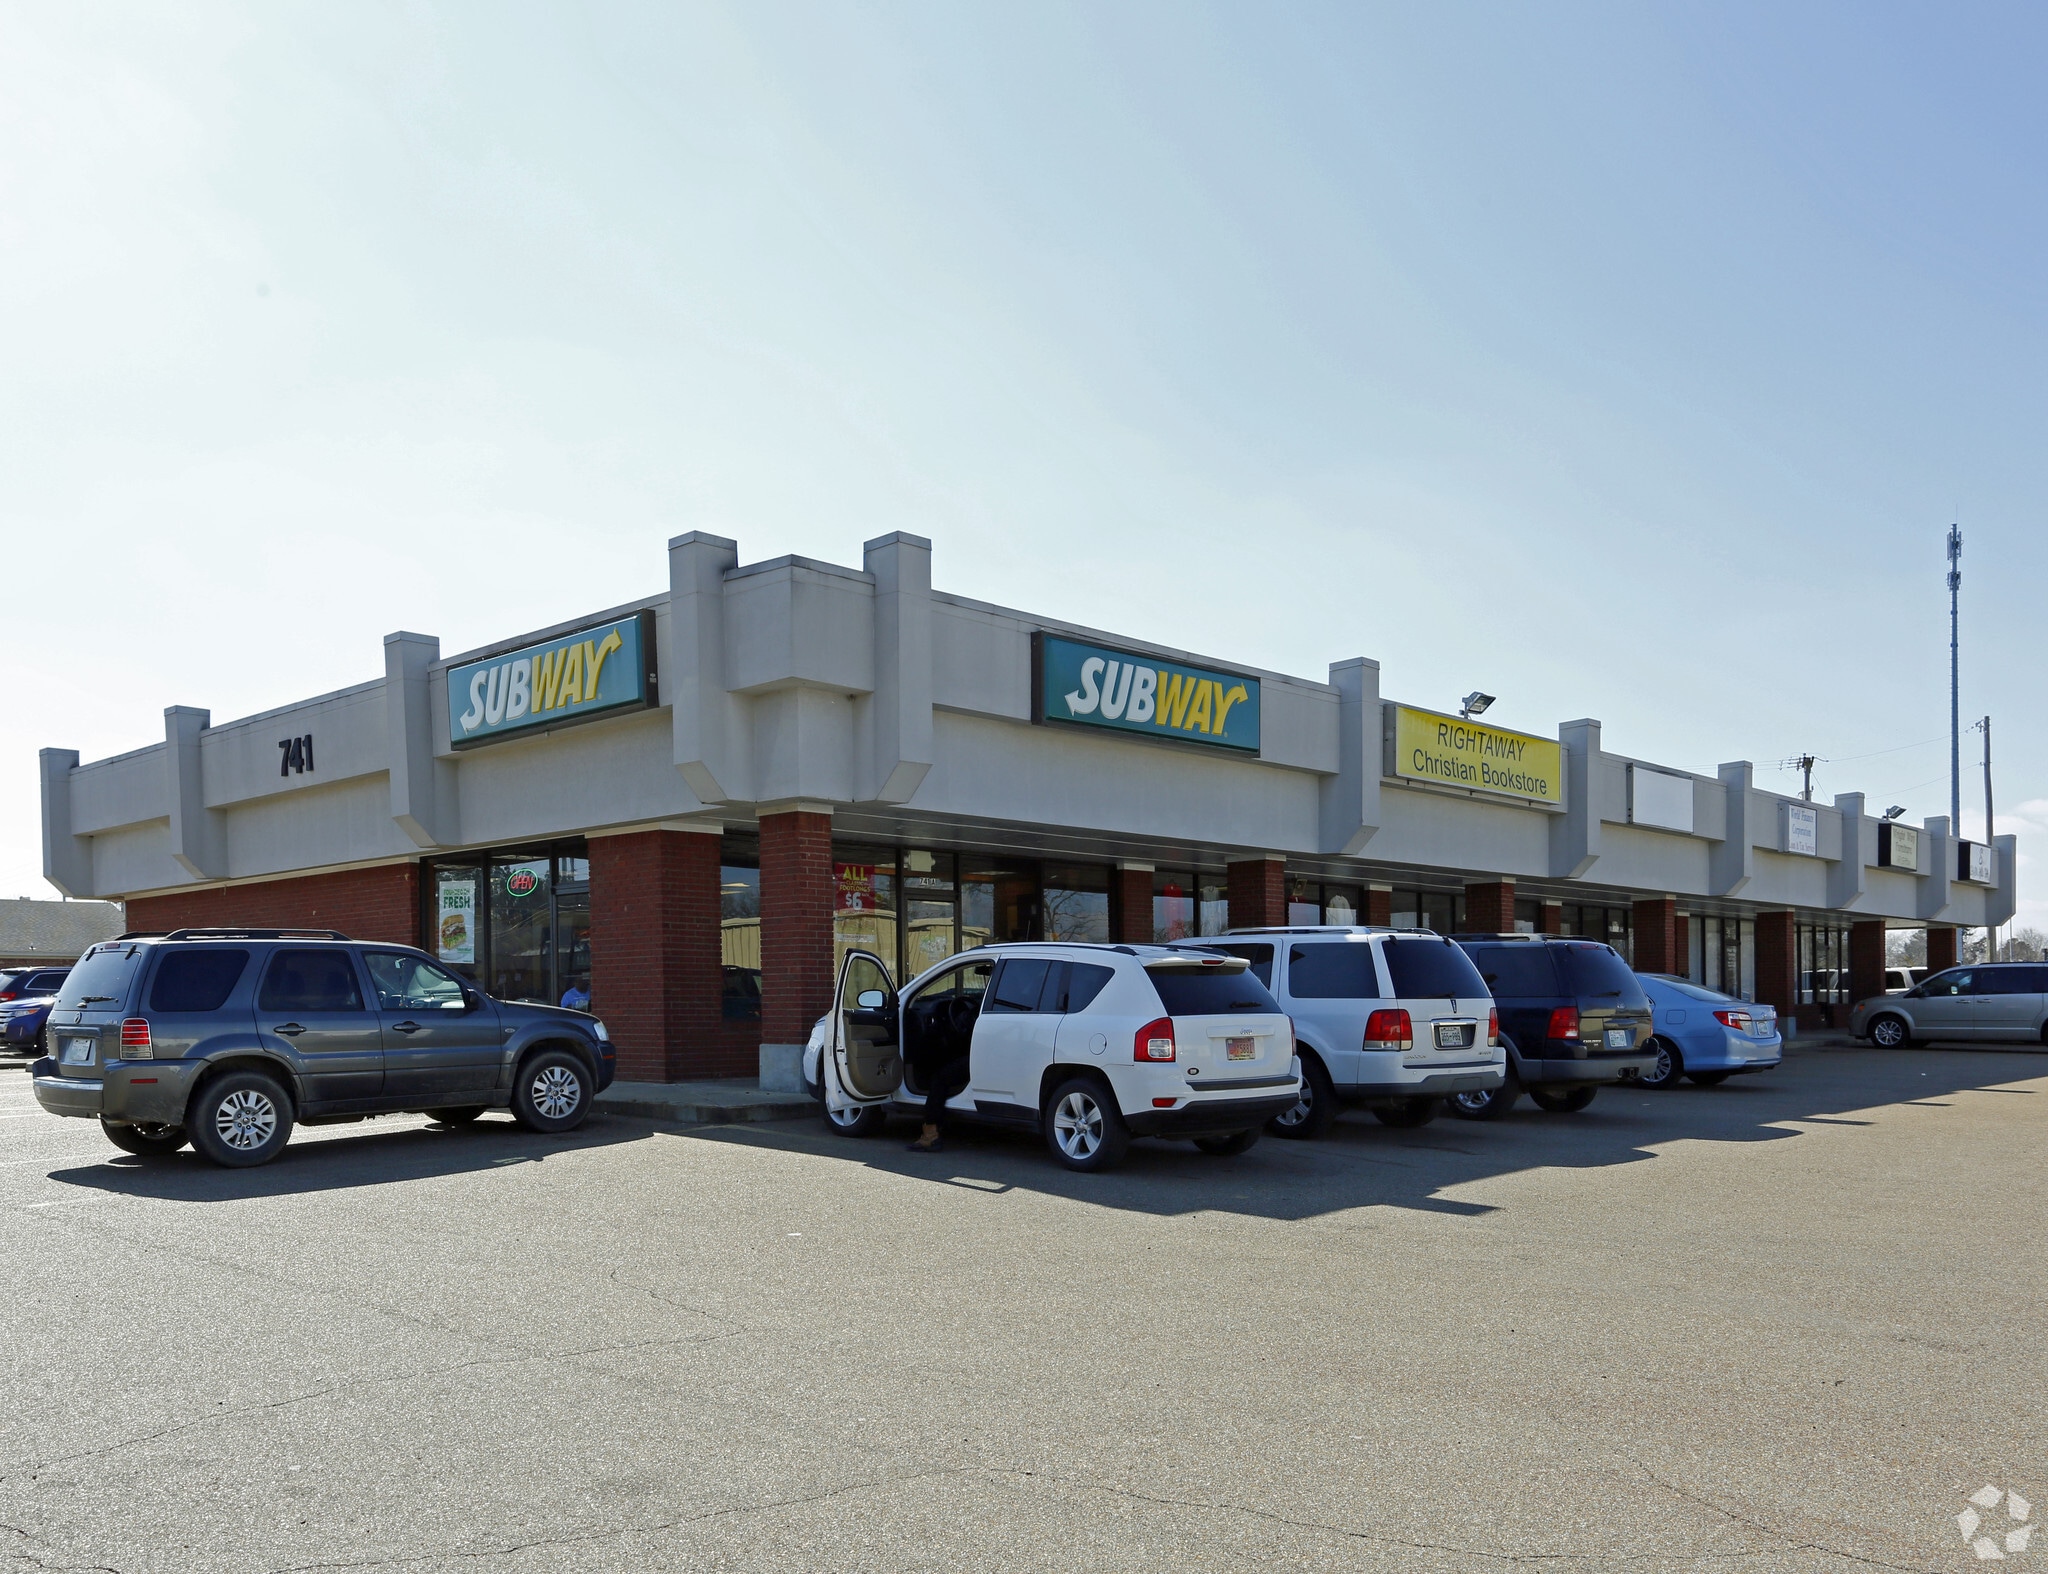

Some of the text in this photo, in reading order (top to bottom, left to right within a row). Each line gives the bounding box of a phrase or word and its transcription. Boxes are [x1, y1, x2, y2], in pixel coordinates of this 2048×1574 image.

[459, 627, 623, 735] SUBWAY
[1064, 656, 1248, 736] SUBWAY
[278, 734, 314, 777] 741
[1437, 722, 1526, 762] RIGHTAWAY
[1413, 748, 1547, 795] Christian Bookstore
[510, 876, 533, 889] OPEN
[843, 866, 867, 881] ALL
[443, 896, 471, 909] FRESH
[840, 884, 871, 893] FOOTLONGS
[846, 892, 862, 911] $6
